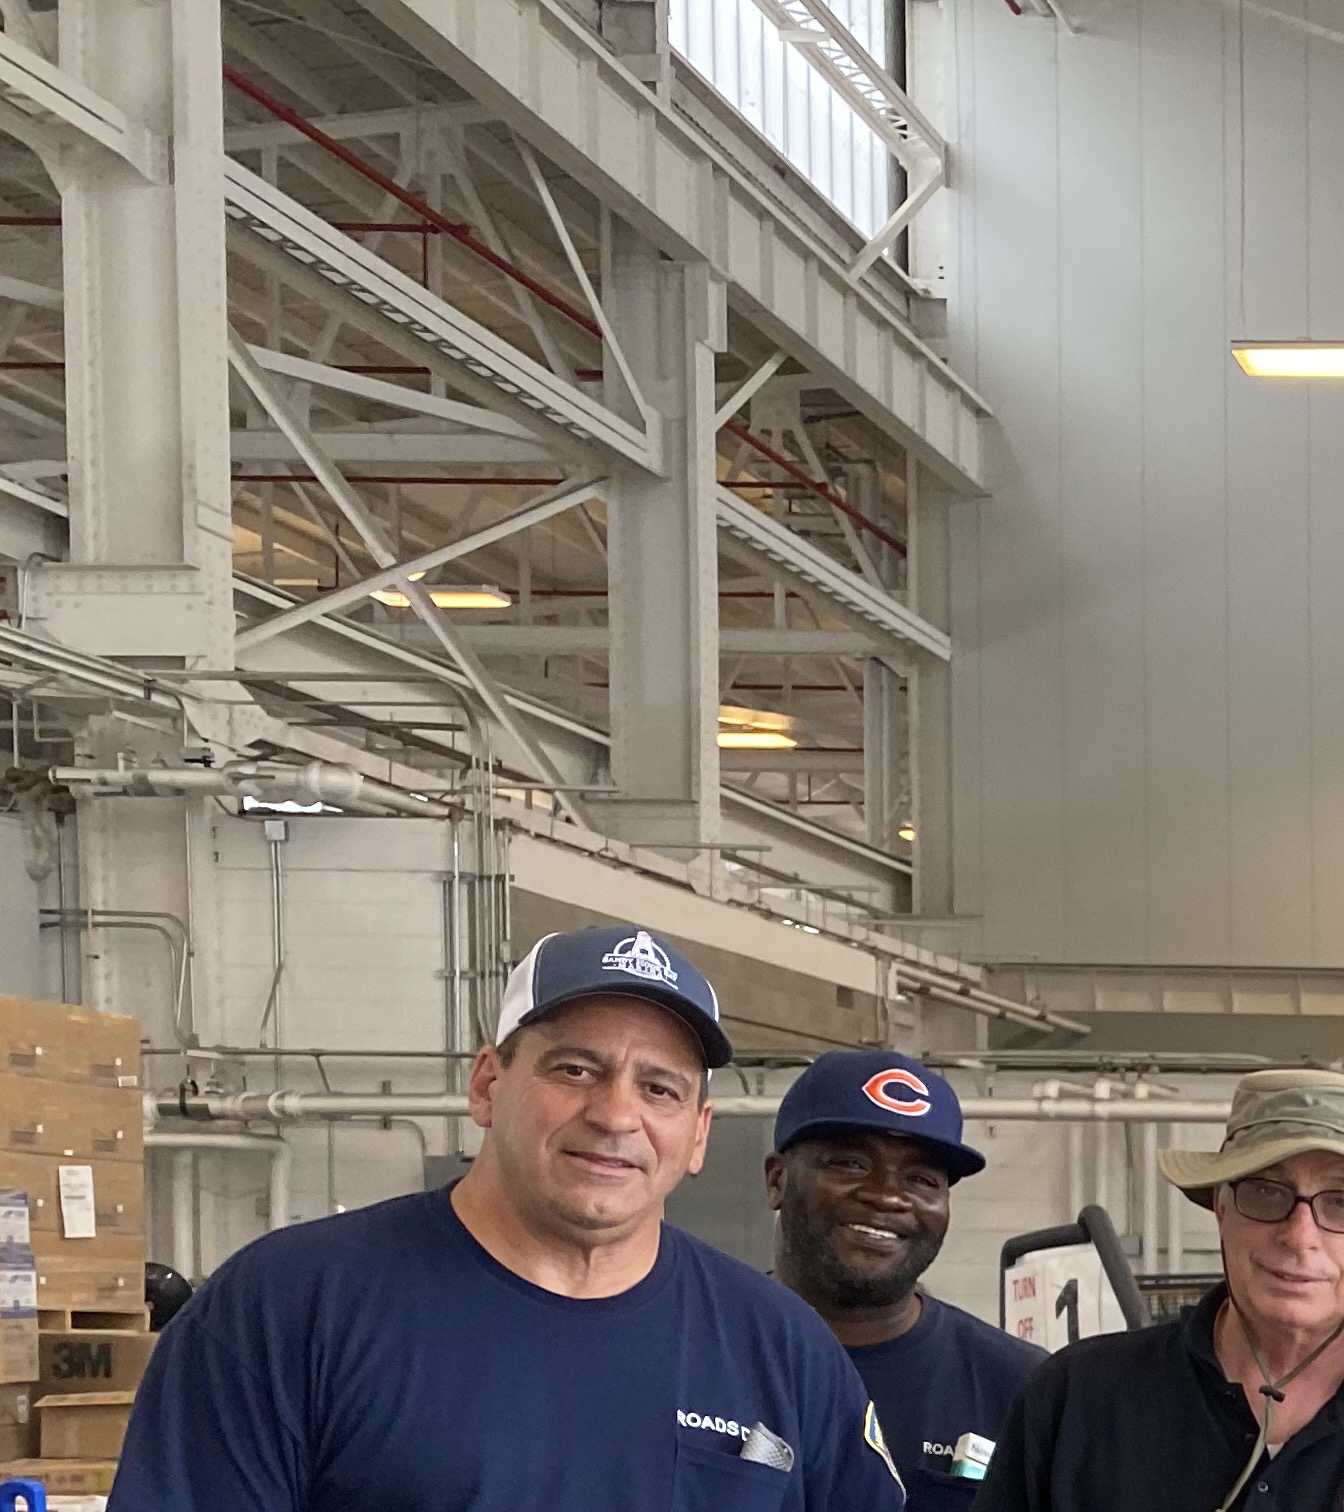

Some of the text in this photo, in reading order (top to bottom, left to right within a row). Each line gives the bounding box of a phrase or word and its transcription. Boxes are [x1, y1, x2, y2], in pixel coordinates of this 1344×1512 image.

[862, 1068, 931, 1116] C
[1012, 1275, 1036, 1300] TURN
[1055, 1277, 1080, 1345] 1
[52, 1342, 114, 1379] 3M
[677, 1408, 739, 1438] ROADS
[923, 1441, 954, 1456] ROA
